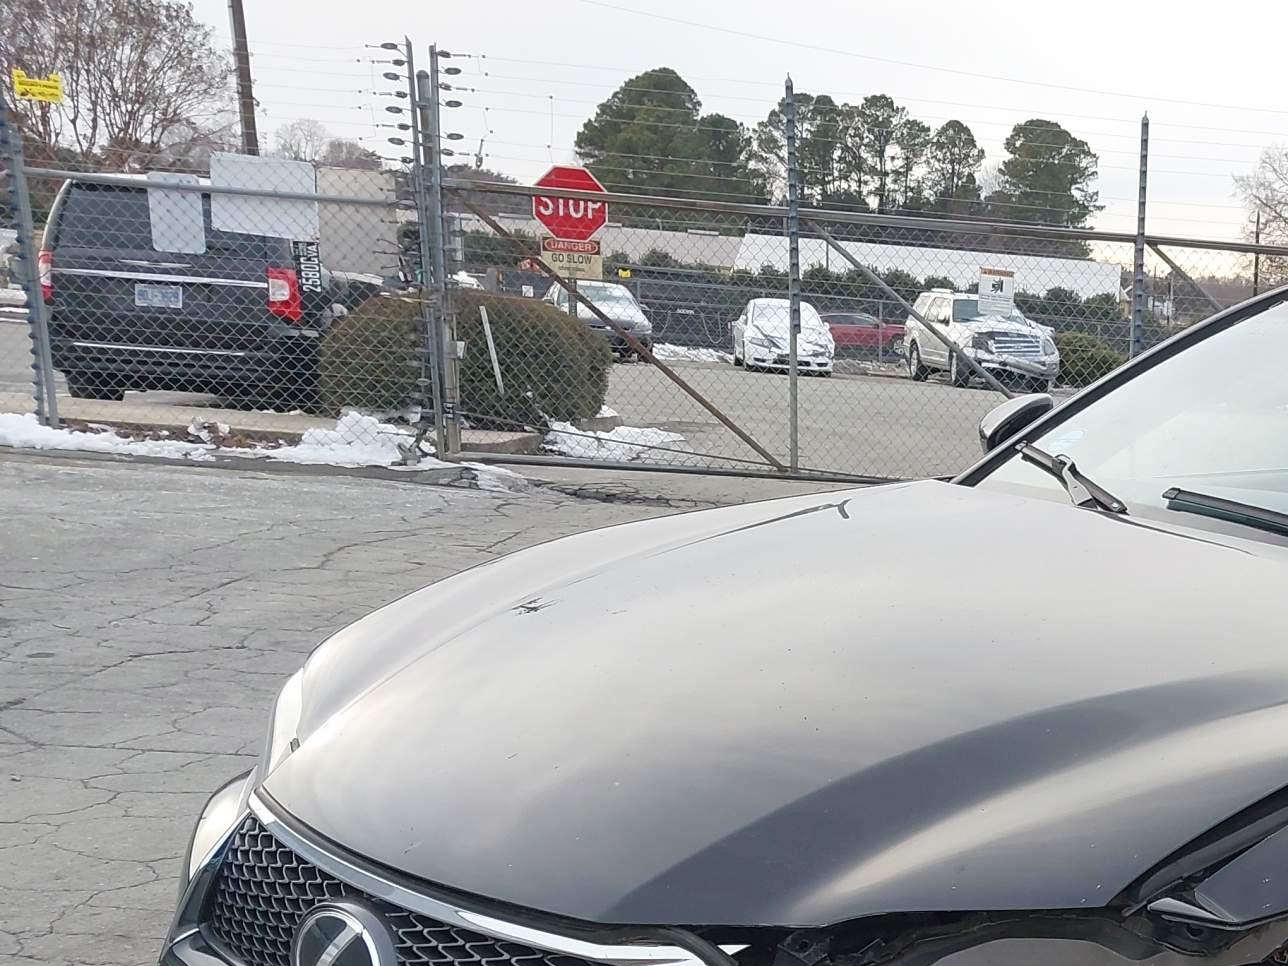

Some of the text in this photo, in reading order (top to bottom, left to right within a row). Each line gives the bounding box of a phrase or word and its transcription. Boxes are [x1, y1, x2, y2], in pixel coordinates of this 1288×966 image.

[540, 196, 602, 219] STOP
[550, 241, 592, 252] DANGER
[551, 253, 592, 265] GO SLOW
